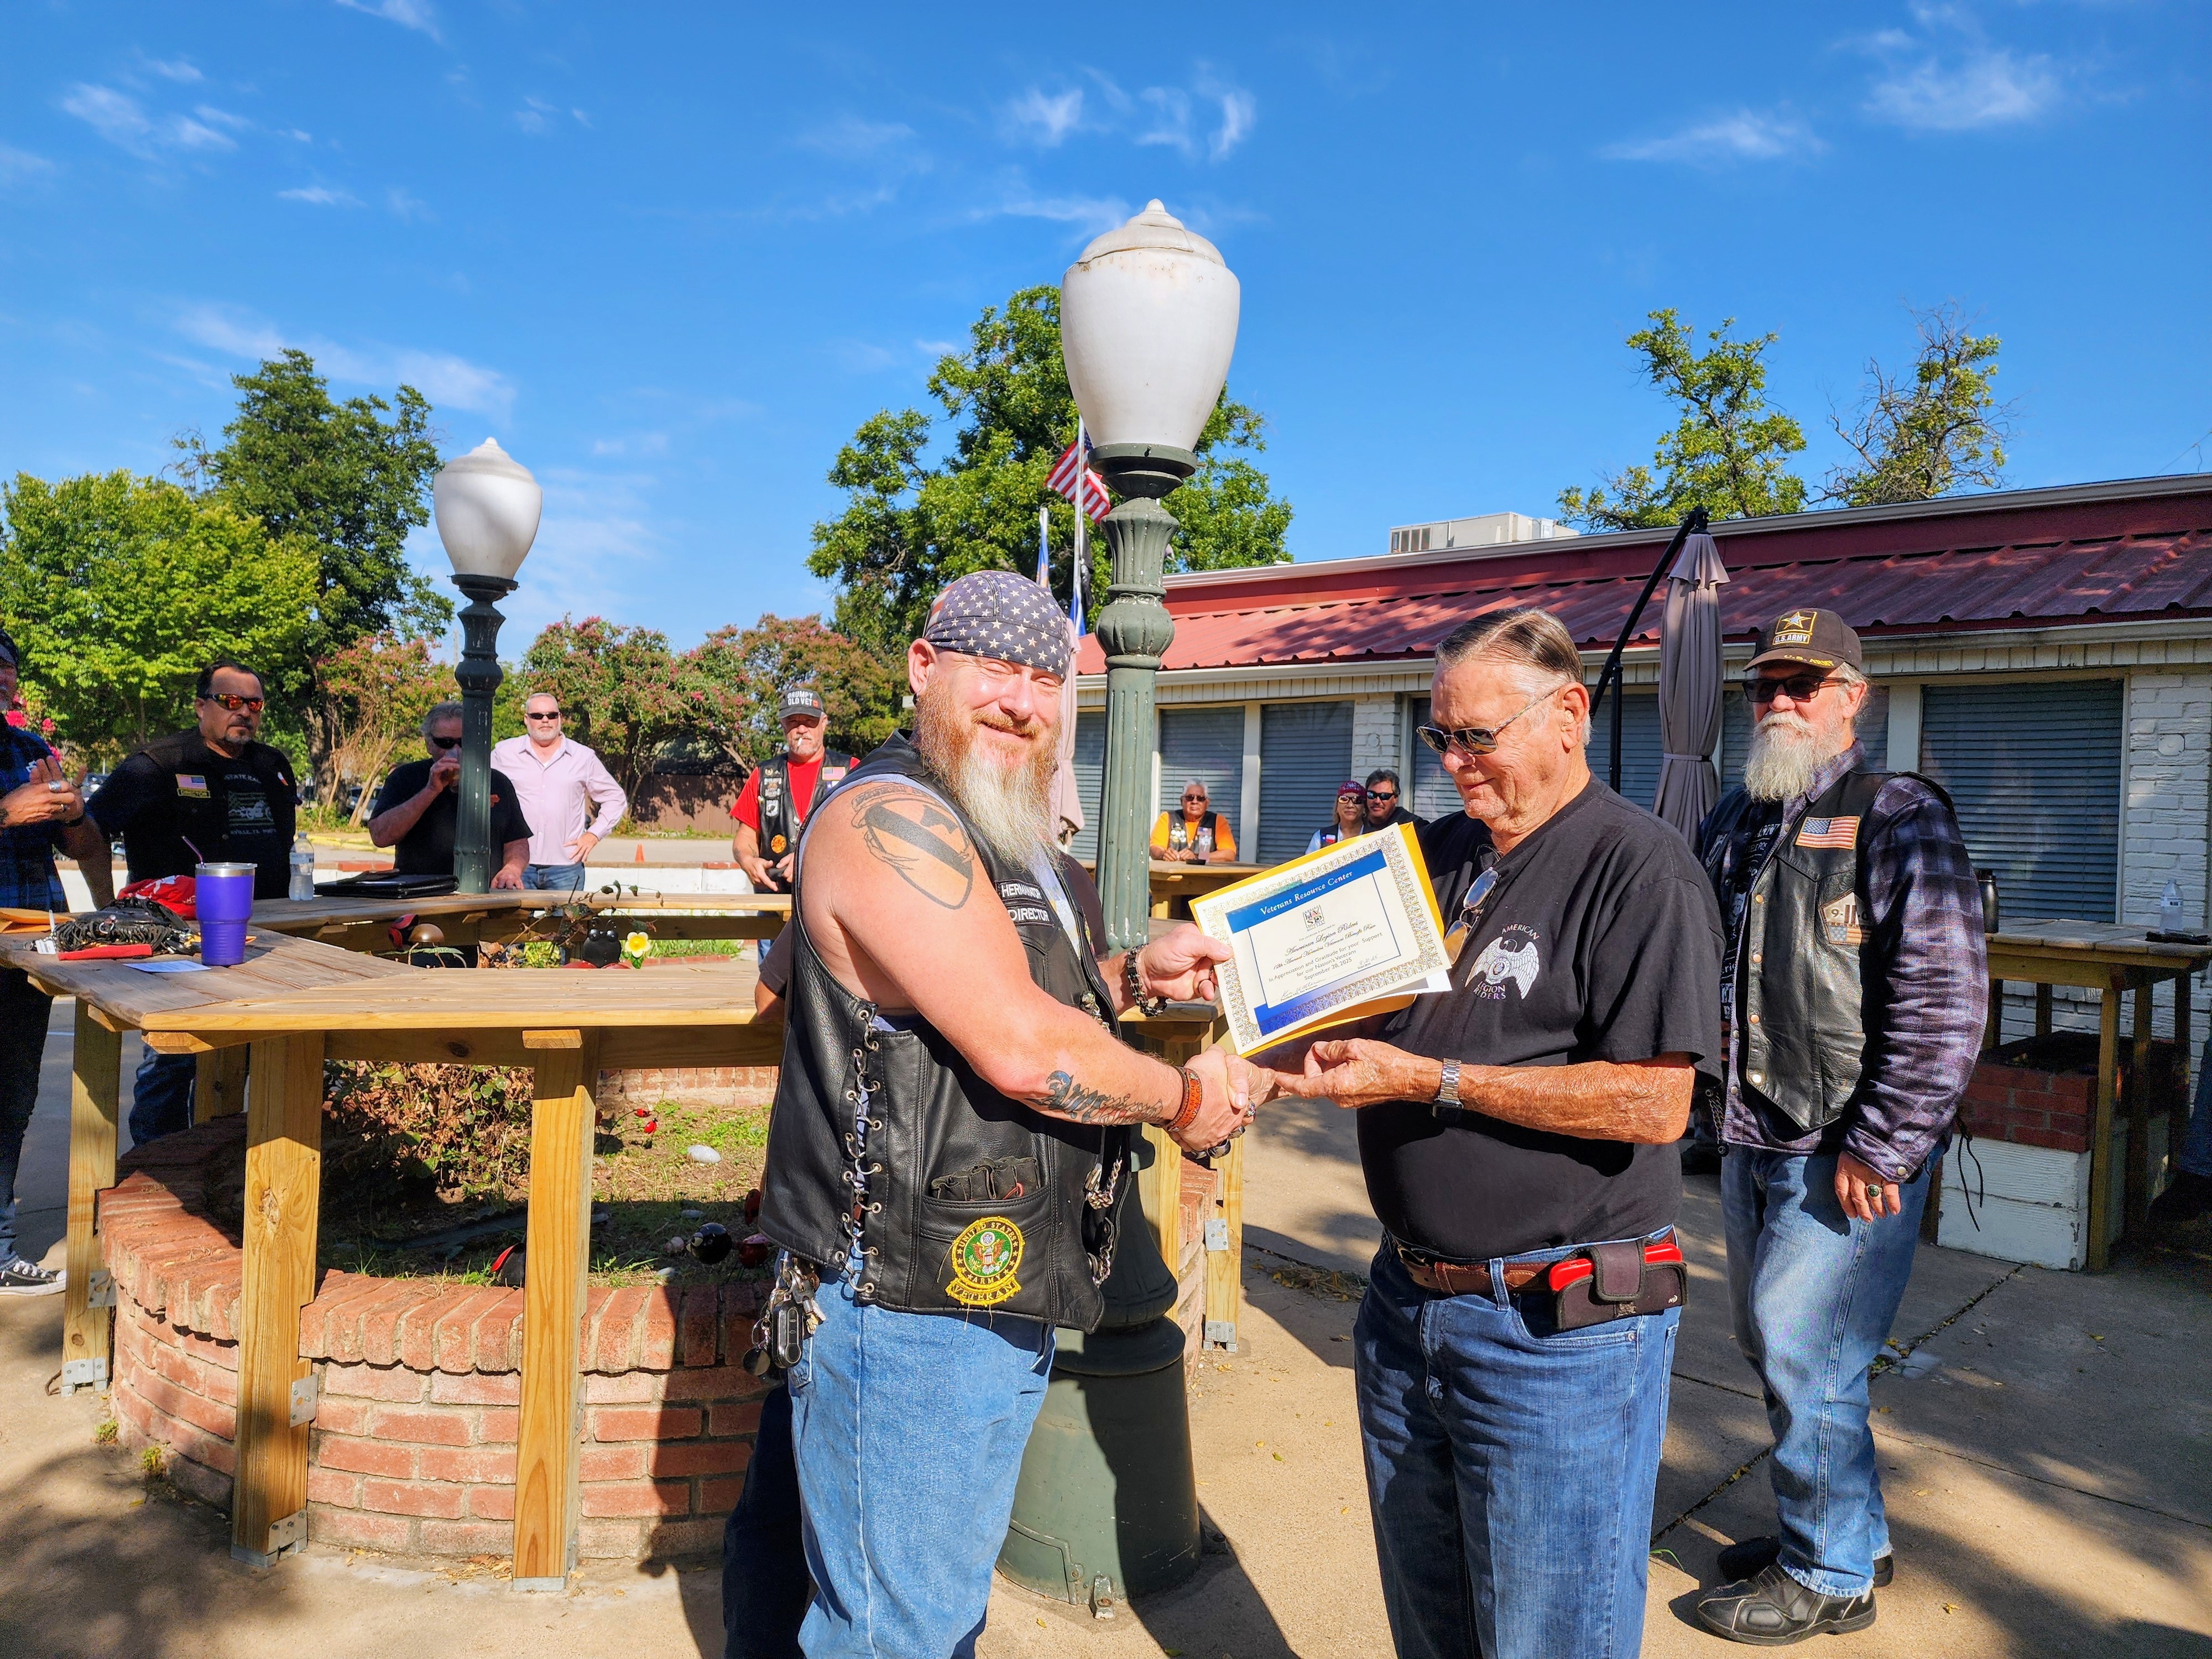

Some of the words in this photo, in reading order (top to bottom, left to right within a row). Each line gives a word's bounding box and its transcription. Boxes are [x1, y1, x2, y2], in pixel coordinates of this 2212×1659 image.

[1809, 658, 1834, 666] ARMY
[787, 690, 813, 699] GRUMPY
[787, 697, 800, 706] OLD
[800, 697, 813, 706] VET
[1001, 883, 1042, 900] HERMANATOR
[1260, 898, 1292, 915] Veterans
[1294, 883, 1326, 902] Resource
[1327, 871, 1353, 886] Center
[1007, 907, 1050, 922] DIRECTOR
[1285, 941, 1314, 956] American
[1316, 931, 1337, 943] Legion
[1337, 921, 1358, 933] Riders
[1501, 923, 1541, 940] AMERICAN
[1274, 964, 1305, 980] Appreciation
[1315, 951, 1338, 962] Gratitude
[1347, 941, 1359, 950] your
[1361, 932, 1383, 943] Support
[1315, 958, 1335, 969] Nation's
[1335, 950, 1357, 961] Veterans
[1304, 967, 1331, 980] September
[1340, 957, 1352, 966] 2025
[1473, 987, 1506, 1000] RIDERS
[1477, 980, 1506, 994] LEGION
[959, 1222, 987, 1248] UNITED
[990, 1222, 1016, 1241] STATES
[972, 1274, 1002, 1285] ARMY
[952, 1282, 1015, 1301] VETERAN
